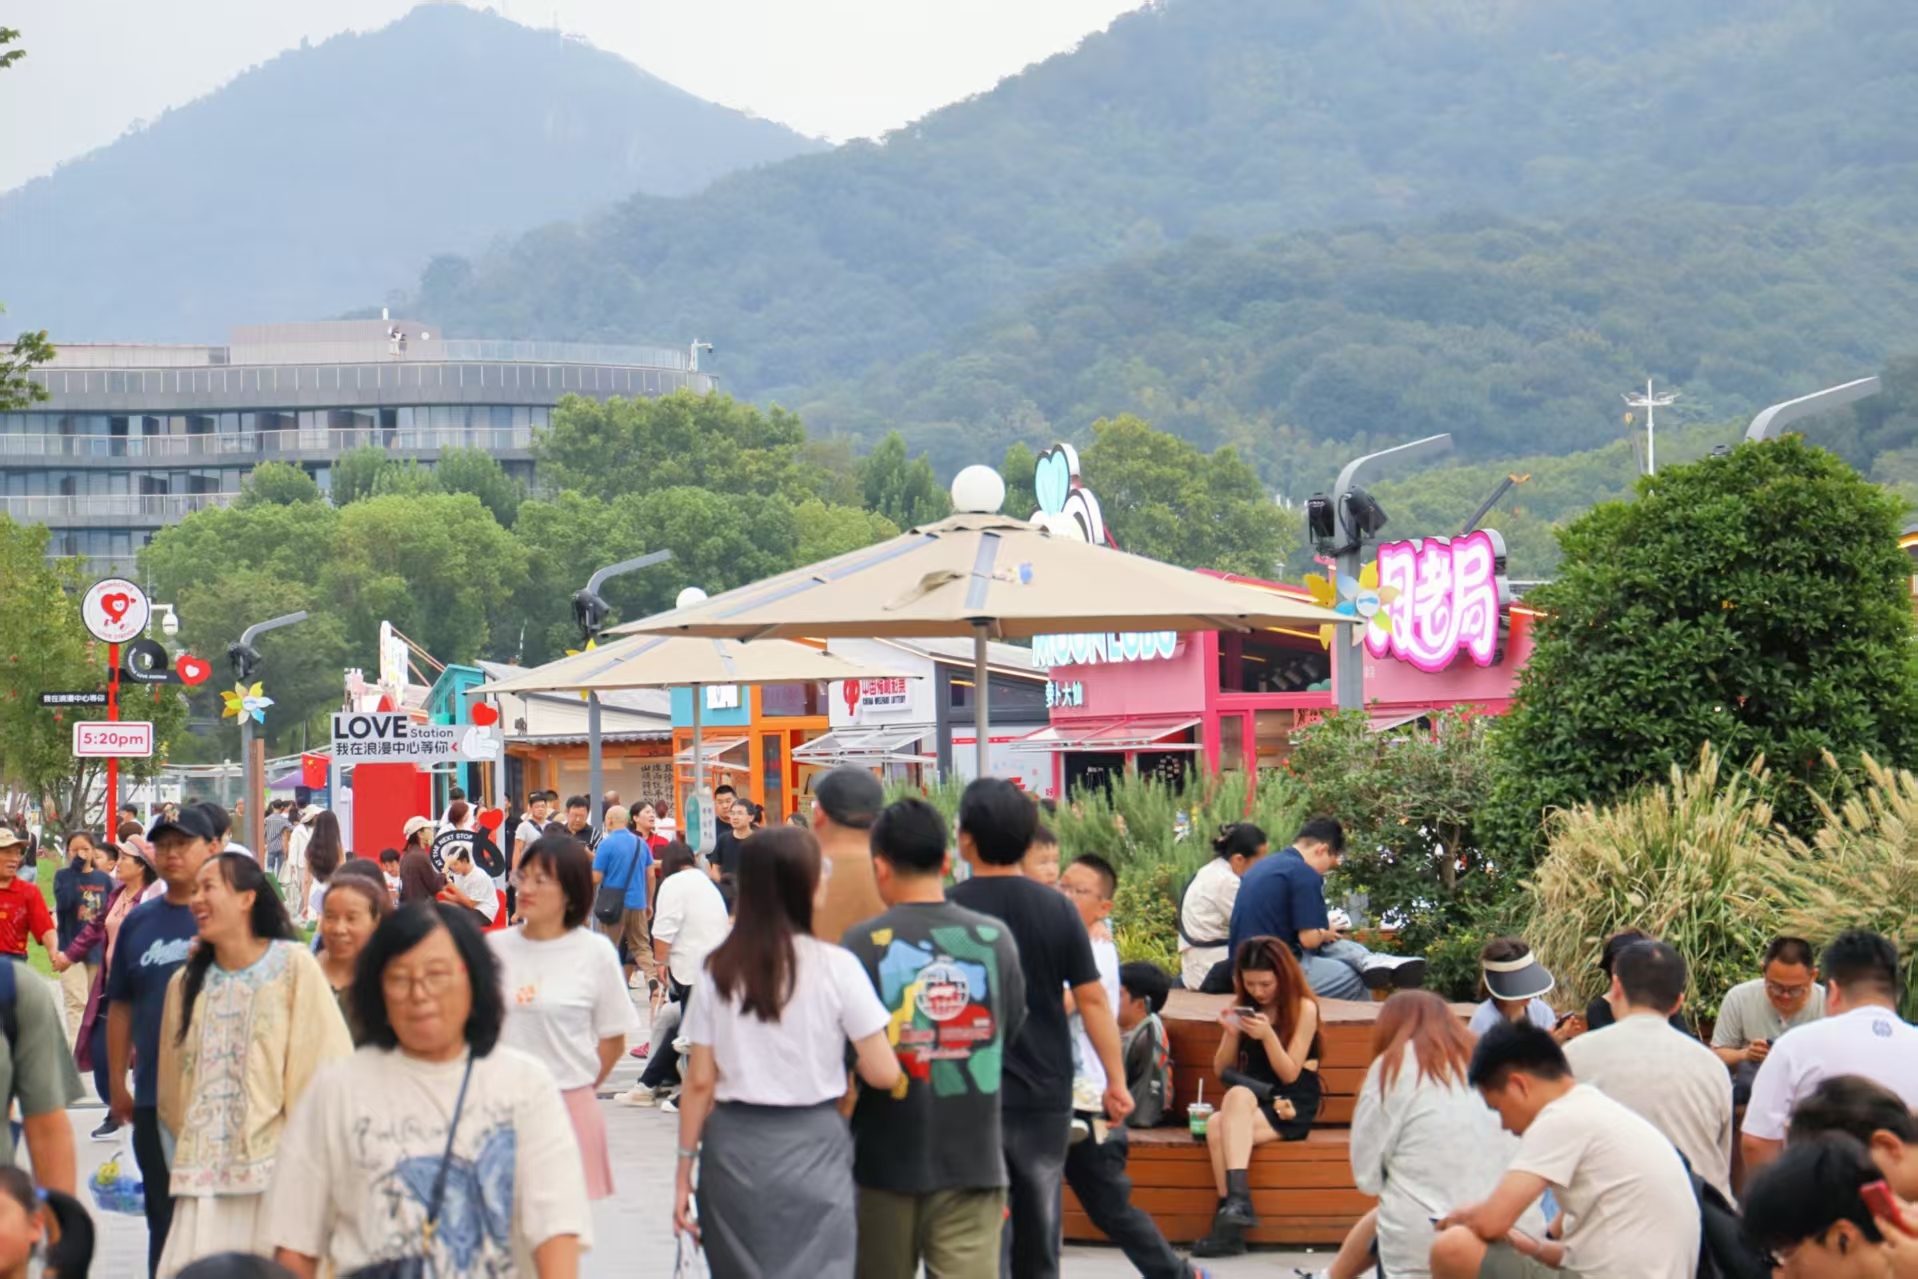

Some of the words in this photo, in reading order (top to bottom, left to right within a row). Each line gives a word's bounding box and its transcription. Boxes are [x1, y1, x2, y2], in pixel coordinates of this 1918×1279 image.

[334, 716, 408, 739] LOVE
[410, 728, 454, 738] Station
[83, 732, 144, 748] 5:20pm
[336, 741, 449, 756] 我在浪漫中心等你
[432, 844, 440, 858] THE
[438, 833, 454, 845] NEXT
